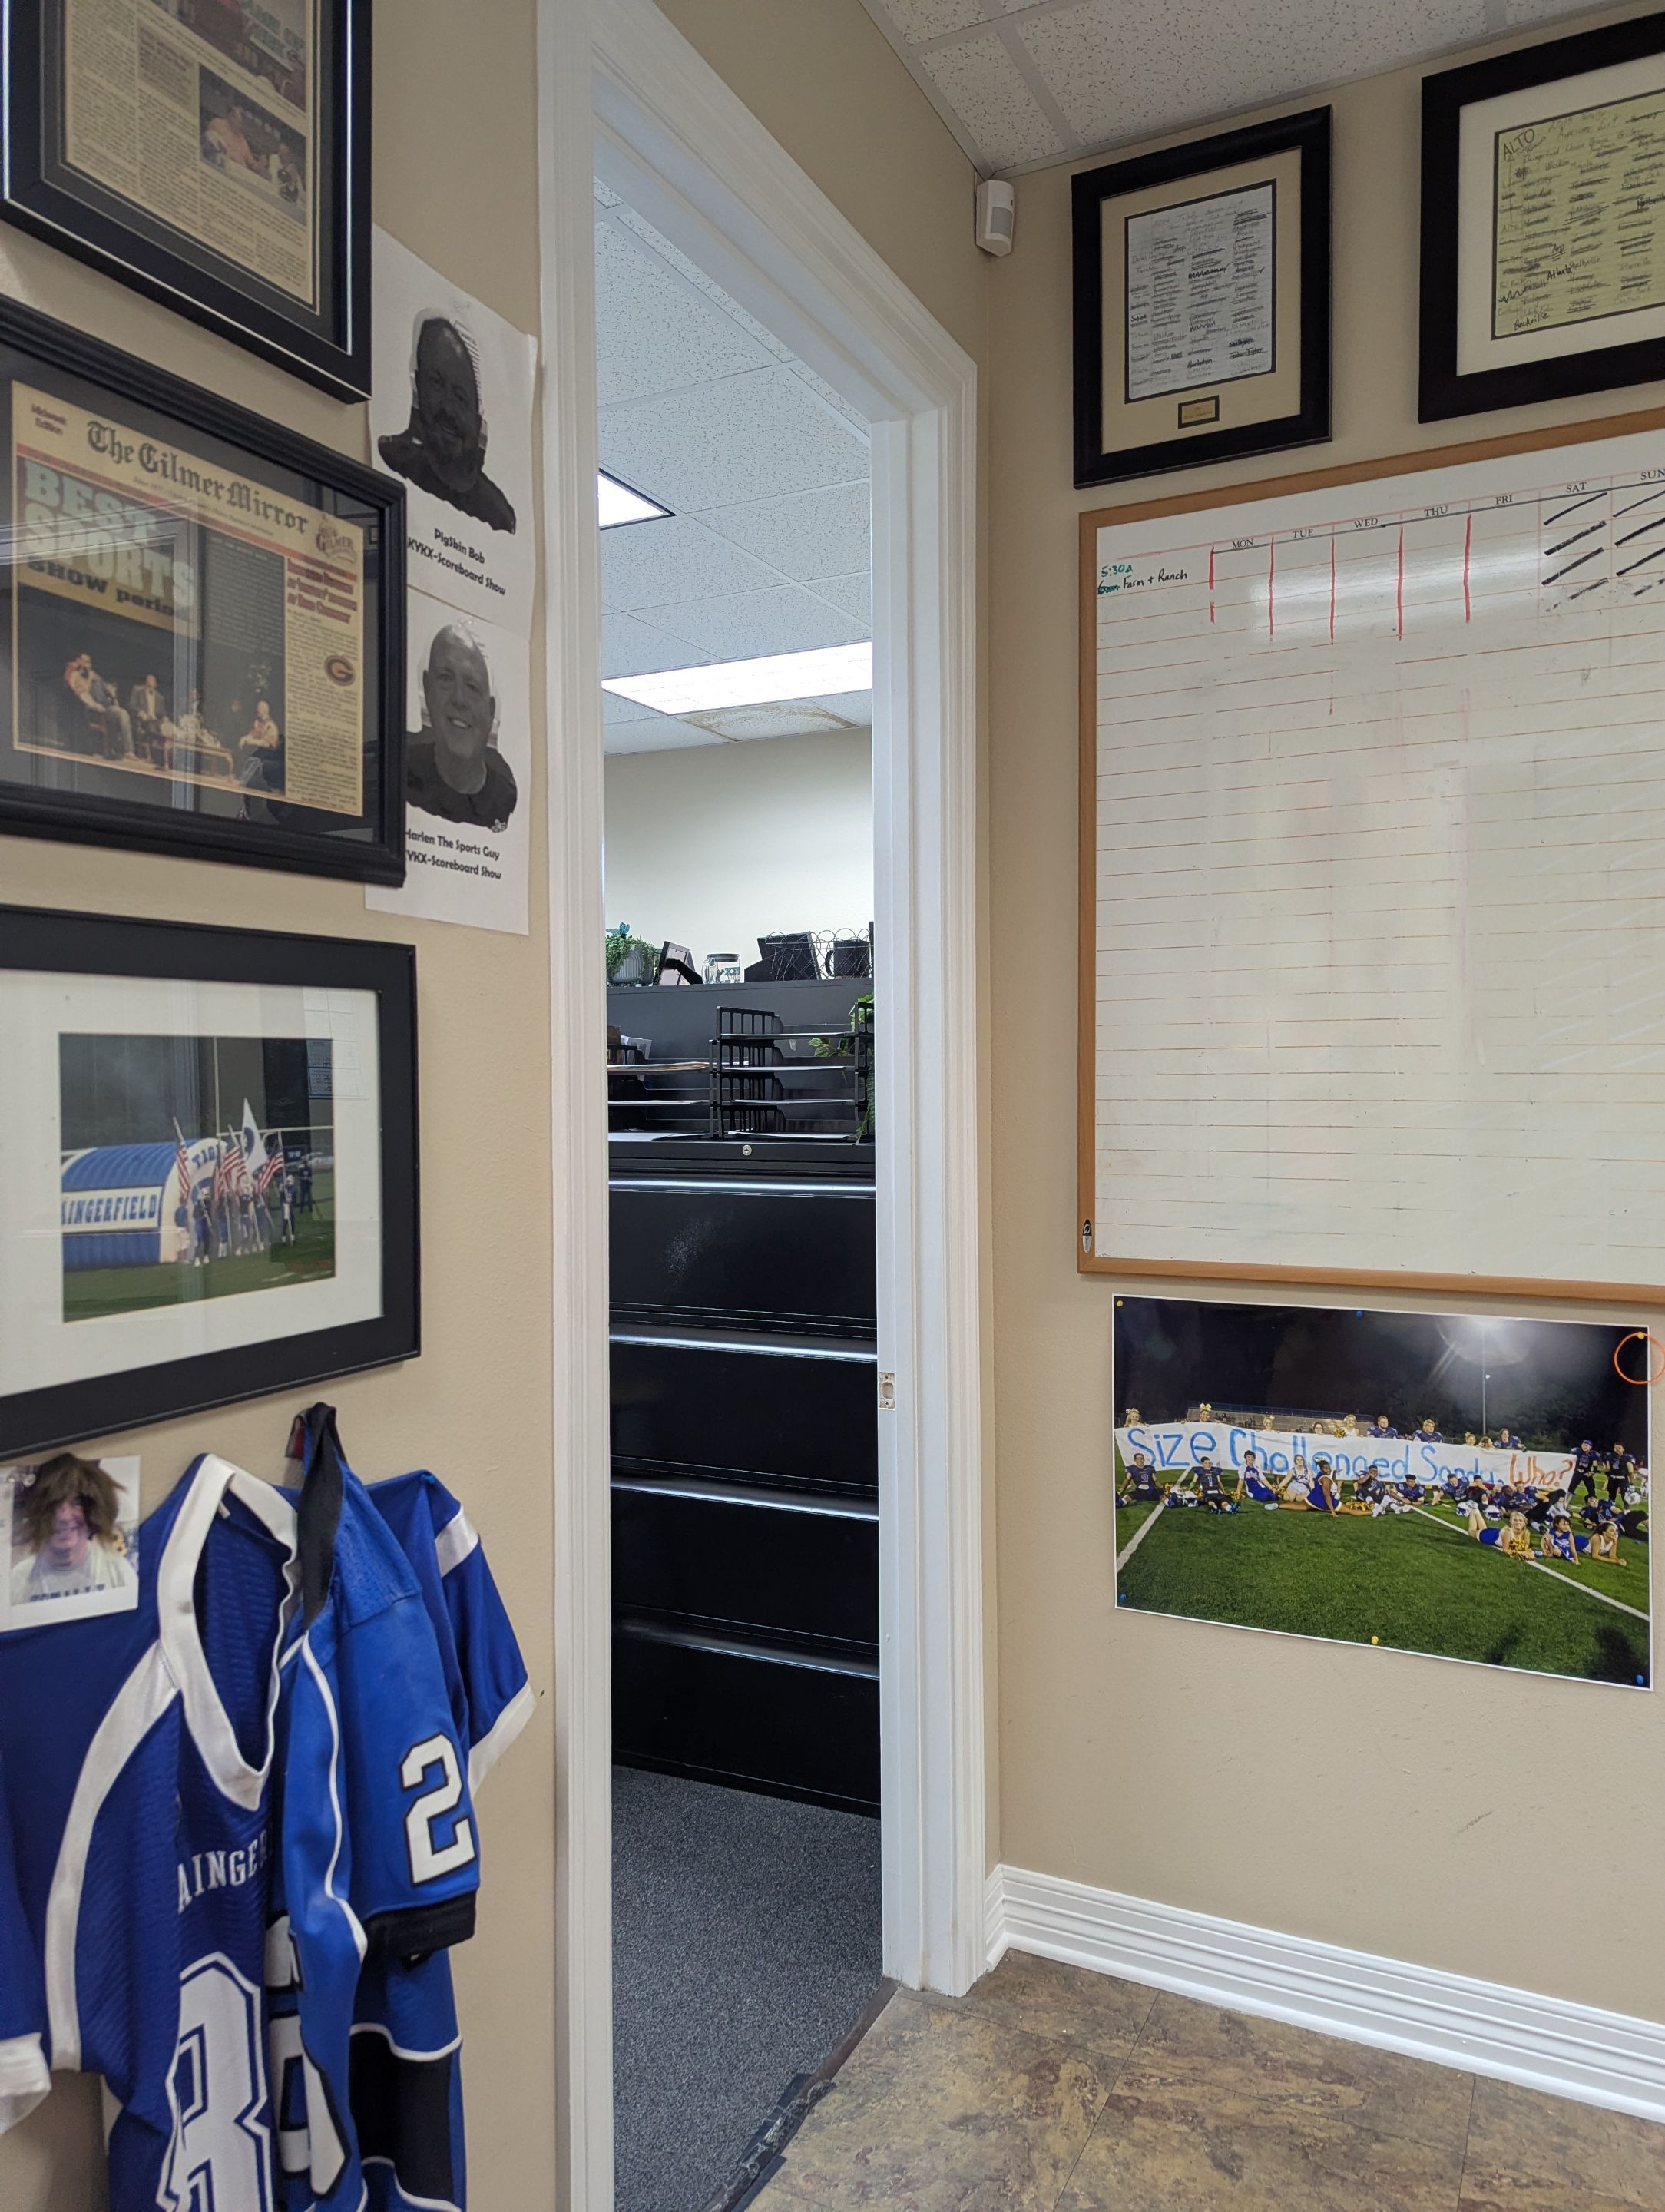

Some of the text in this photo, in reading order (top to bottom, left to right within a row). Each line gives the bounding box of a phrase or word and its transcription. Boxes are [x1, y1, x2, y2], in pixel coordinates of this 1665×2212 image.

[87, 420, 134, 465] The
[138, 442, 225, 500] Gilmer
[227, 480, 309, 534] Mirror
[1232, 468, 1665, 549] MON TUE WED THU FRI SAT SUN
[407, 537, 506, 595] KYKX-Scoreboard Show
[468, 546, 485, 564] Bob
[1123, 575, 1144, 589] Farm
[1158, 568, 1188, 582] Ranch
[406, 849, 501, 879] YKX-Scoreboard Show
[437, 835, 454, 849] The
[455, 839, 481, 855] Sports
[482, 846, 500, 861] Guy
[191, 1144, 220, 1169] TIG
[1127, 1427, 1217, 1467] Size
[1509, 1453, 1574, 1487] Who?
[400, 1734, 476, 1886] 2
